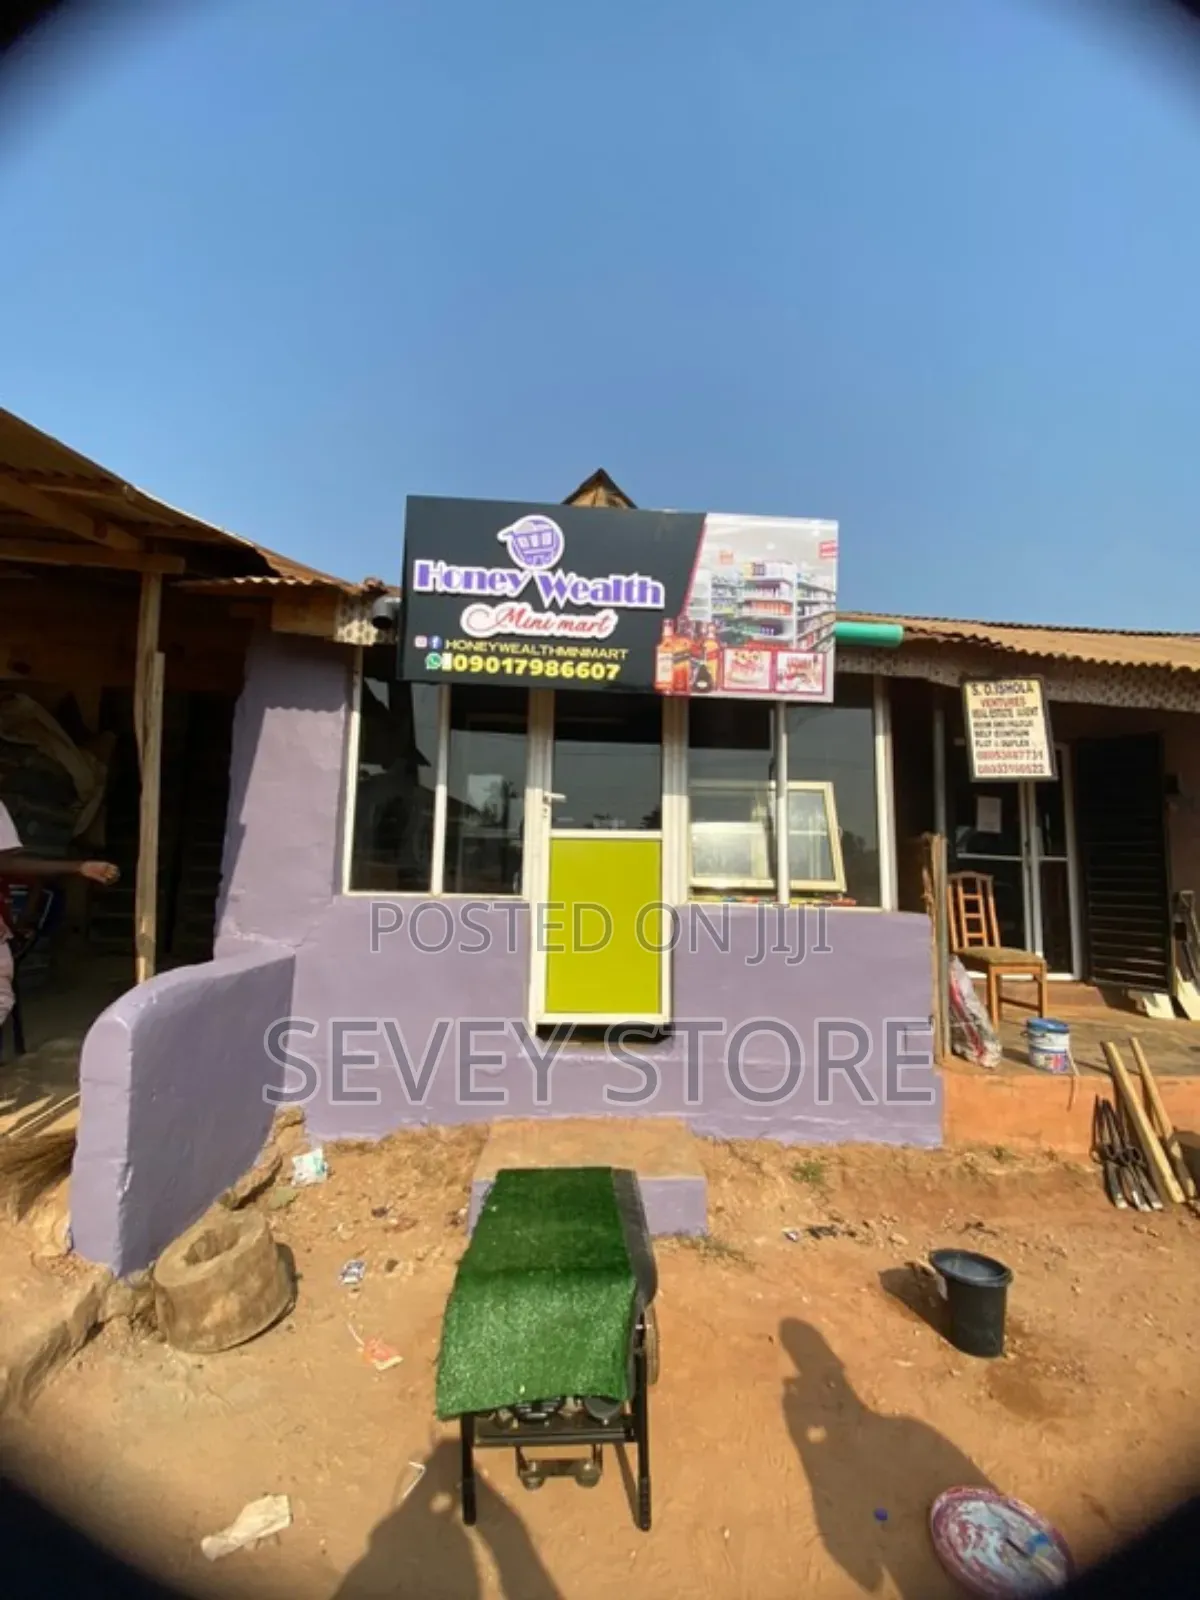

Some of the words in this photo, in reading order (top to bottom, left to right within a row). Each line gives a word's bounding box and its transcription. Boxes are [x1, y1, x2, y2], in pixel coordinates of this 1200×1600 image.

[414, 560, 532, 596] Honey
[536, 569, 663, 608] Wealth
[466, 607, 554, 632] Mini
[557, 614, 612, 634] mart
[453, 654, 620, 680] 09017986607
